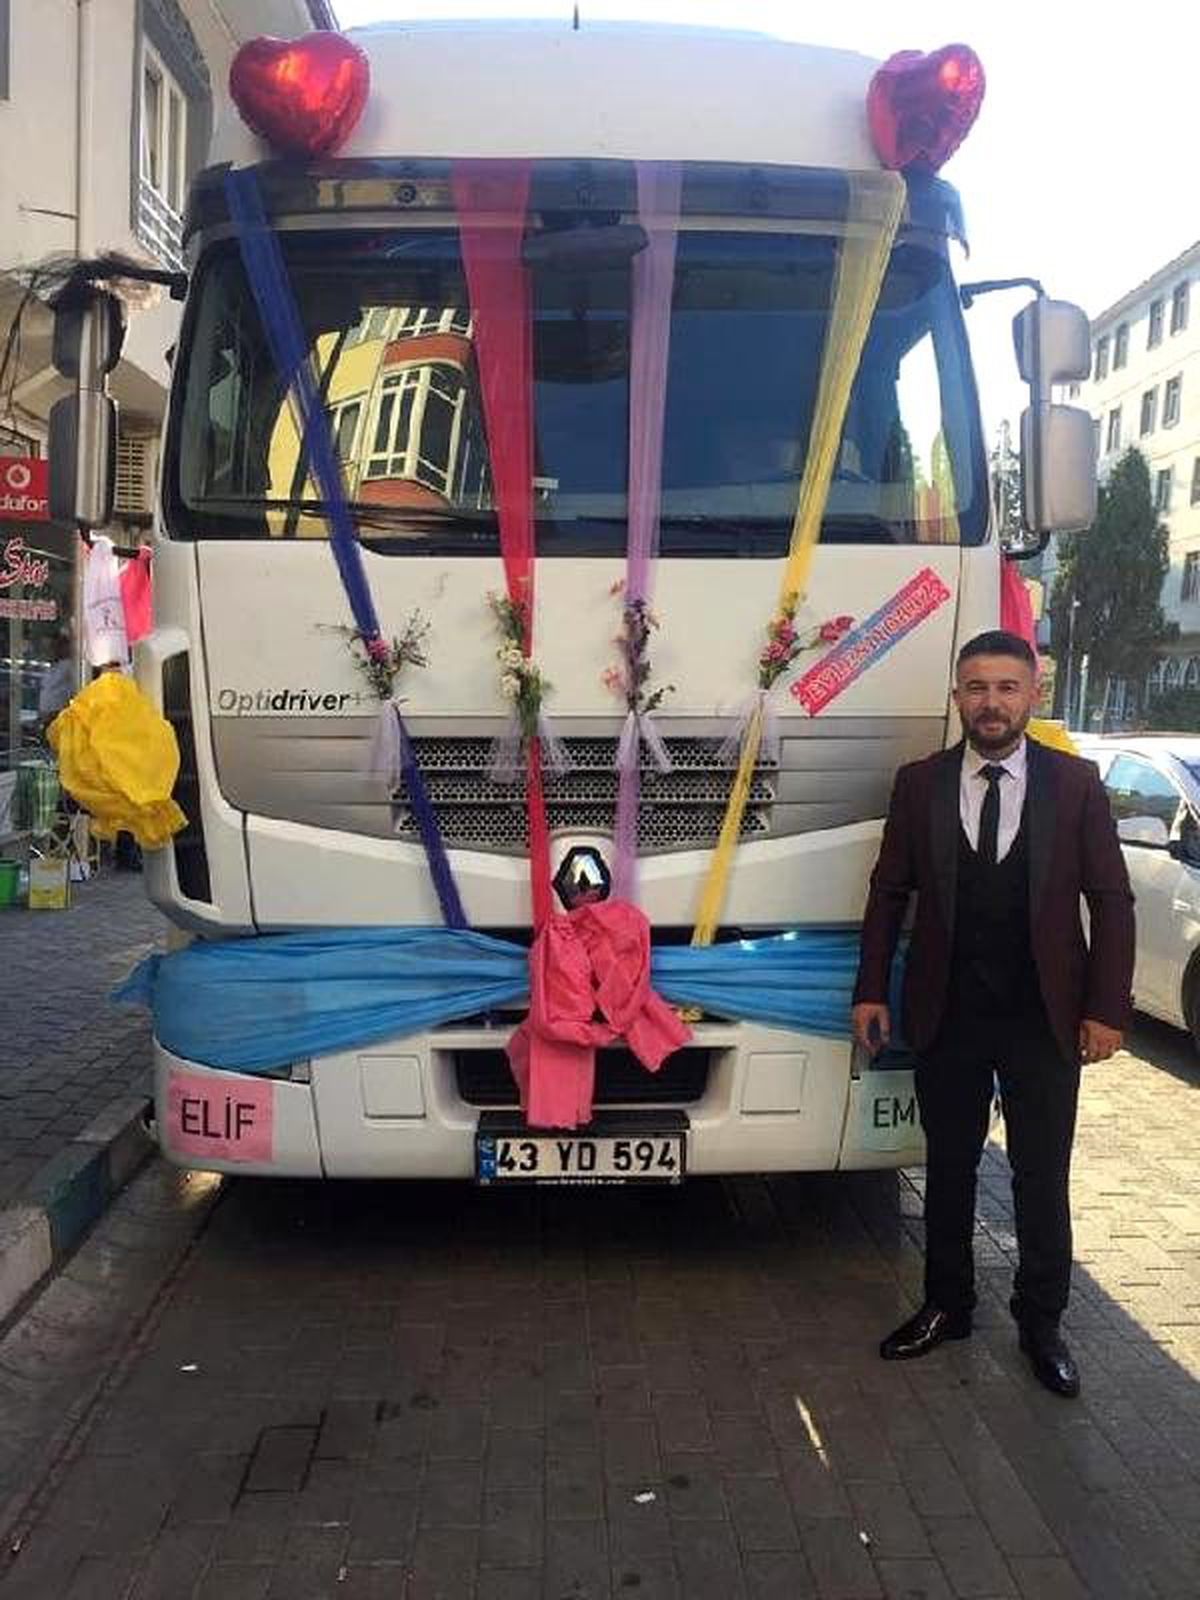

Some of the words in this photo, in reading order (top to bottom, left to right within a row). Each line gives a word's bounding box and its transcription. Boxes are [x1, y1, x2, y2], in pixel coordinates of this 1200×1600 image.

[181, 1096, 256, 1140] ELİF
[499, 1141, 539, 1171] 43
[556, 1141, 597, 1171] YD
[613, 1141, 677, 1171] 594
